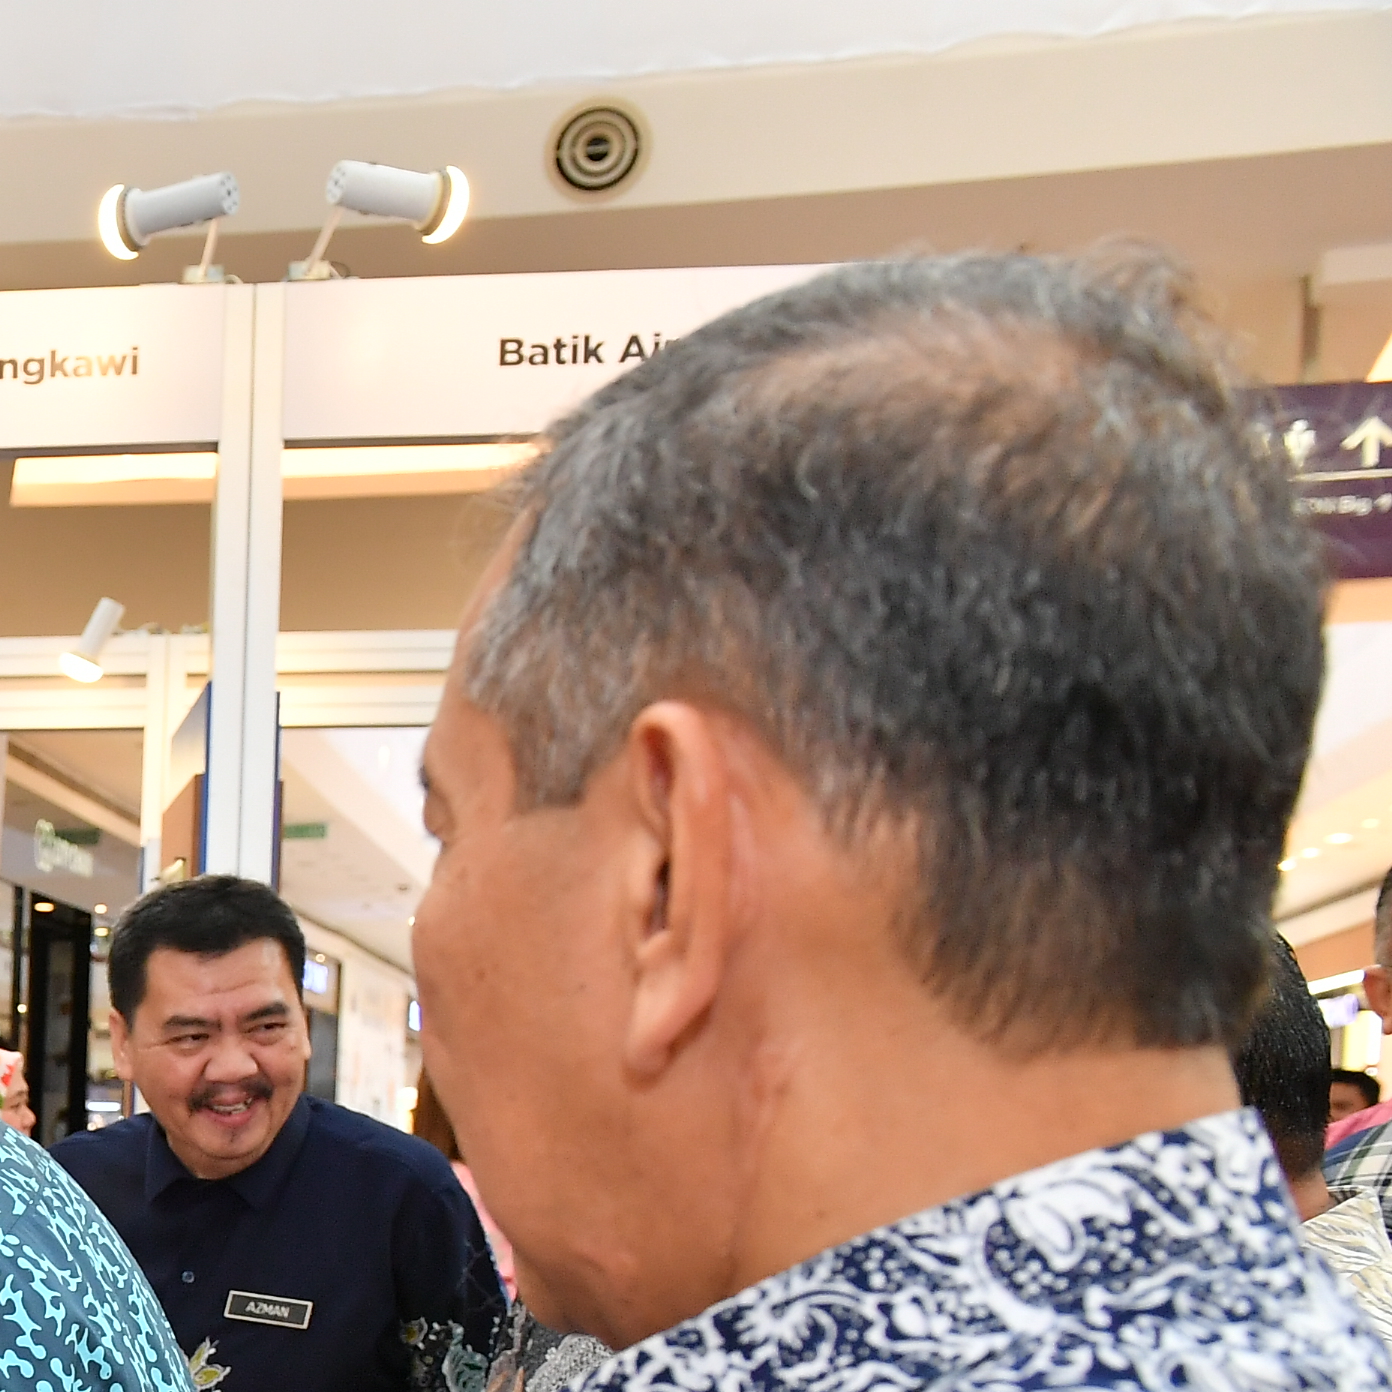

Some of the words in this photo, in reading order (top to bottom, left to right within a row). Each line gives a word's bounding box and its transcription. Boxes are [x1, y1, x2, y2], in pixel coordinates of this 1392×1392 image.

[499, 334, 605, 367] Batik
[618, 331, 678, 364] Ai
[244, 1301, 291, 1319] AZMAN
